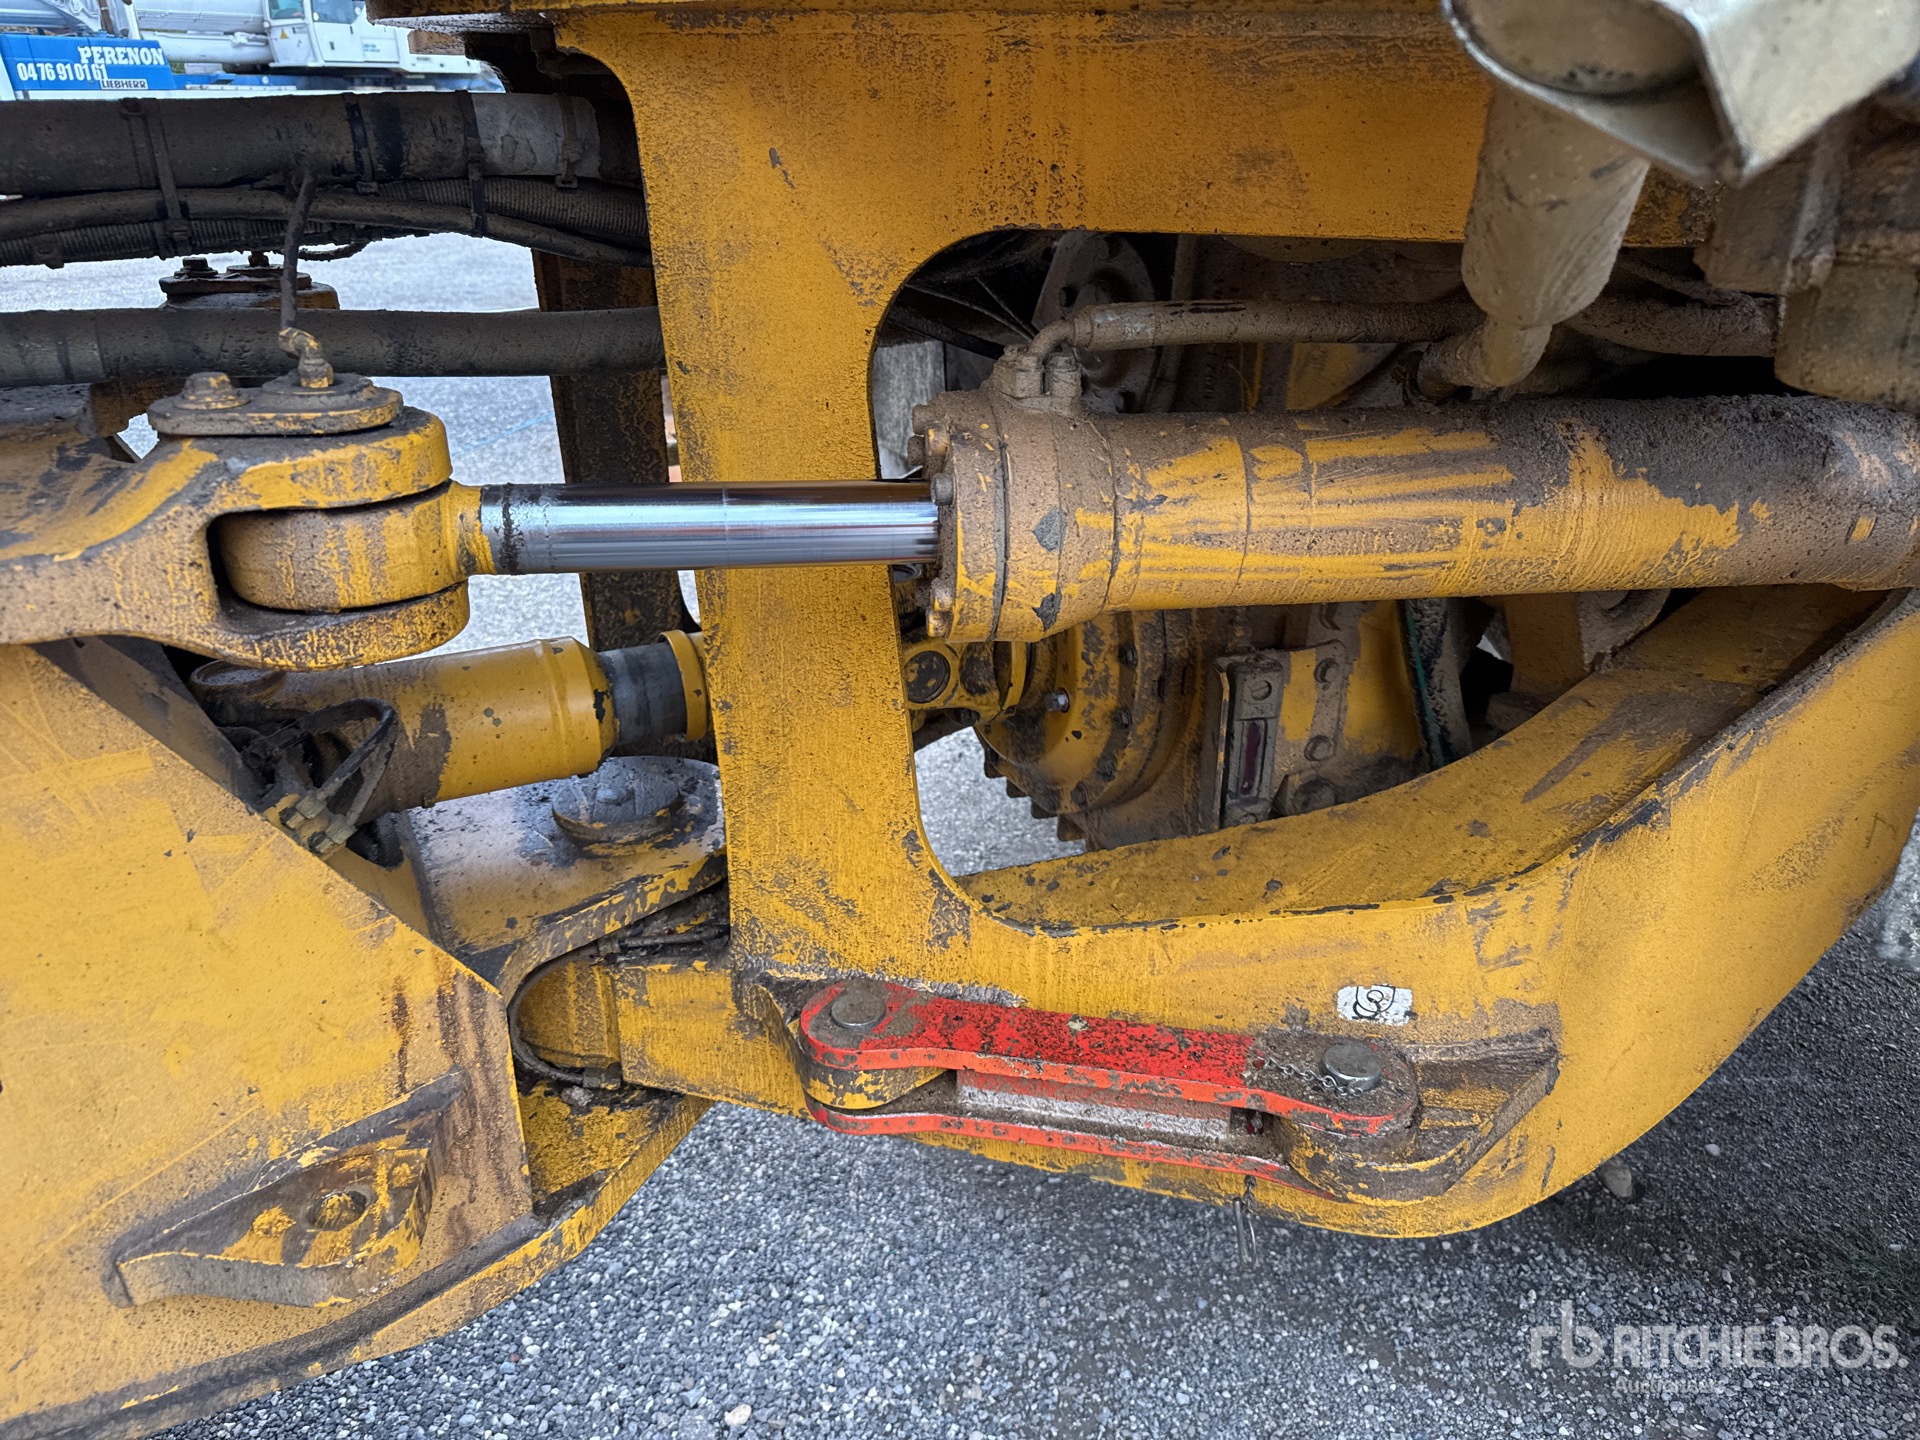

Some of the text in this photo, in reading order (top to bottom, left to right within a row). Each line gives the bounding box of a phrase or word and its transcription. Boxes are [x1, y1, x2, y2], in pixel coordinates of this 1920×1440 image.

[78, 46, 165, 65] PERENON
[17, 63, 109, 81] 04 76 91 01 61
[102, 80, 147, 89] LIEBHERR
